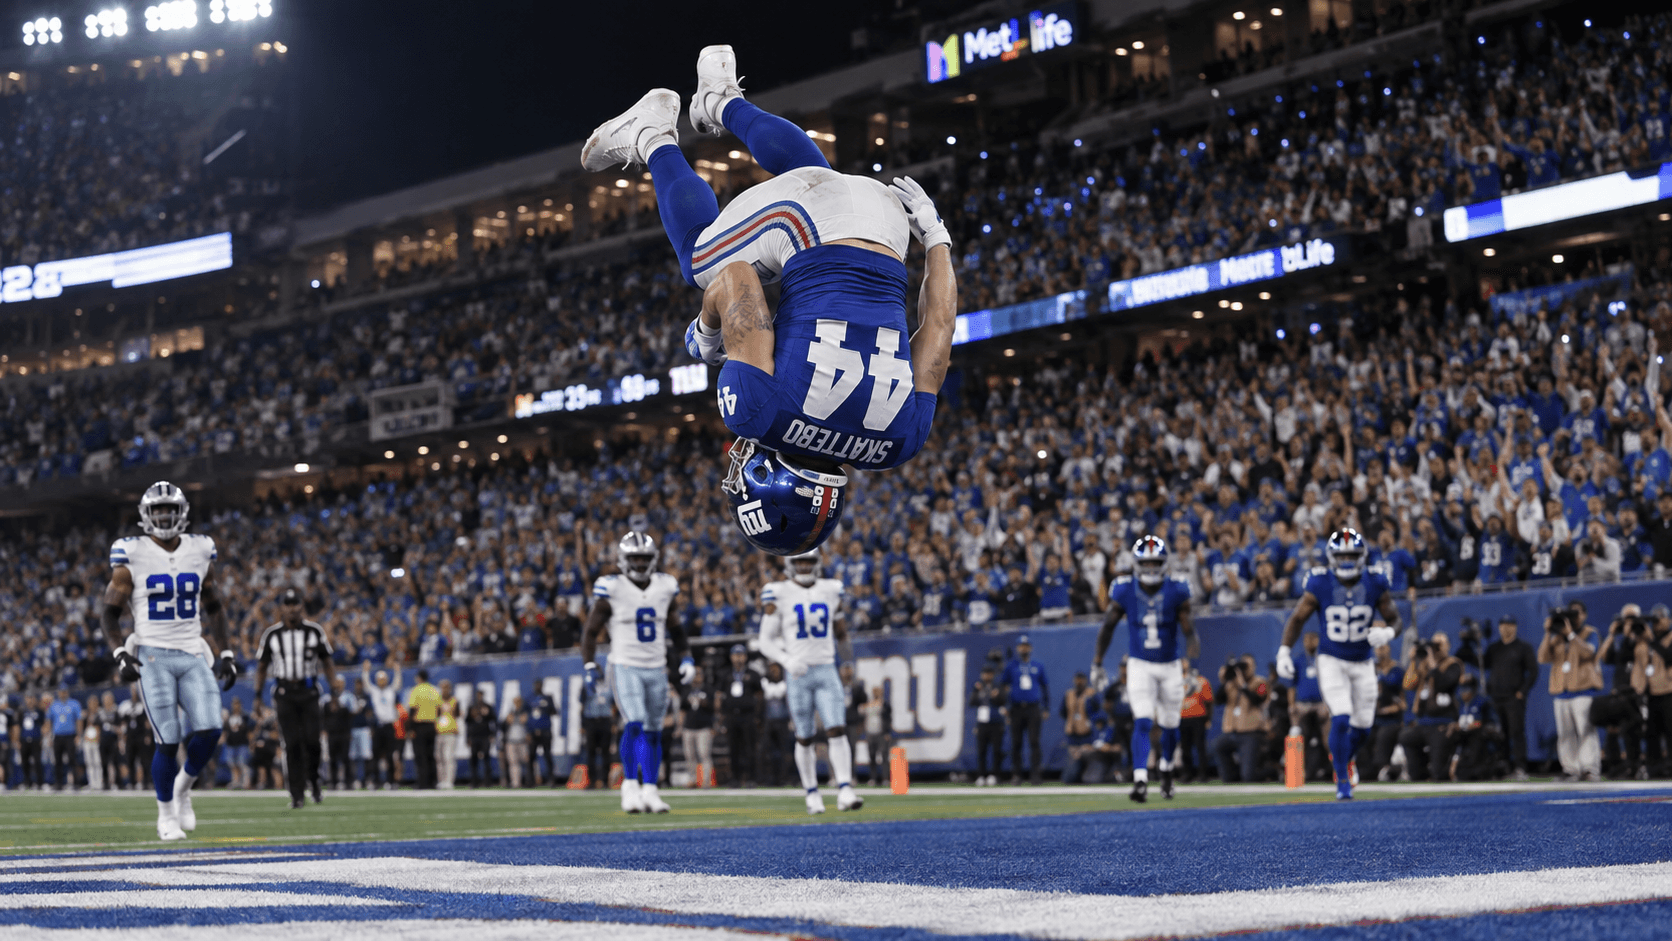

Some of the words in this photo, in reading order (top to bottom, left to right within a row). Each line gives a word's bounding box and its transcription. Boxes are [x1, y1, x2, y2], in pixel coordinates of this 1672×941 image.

[803, 318, 913, 431] 44
[782, 418, 893, 464] SKATTEBO
[146, 573, 200, 620] 28
[636, 607, 656, 643] 6
[794, 603, 830, 639] 13
[1142, 614, 1162, 649] 1
[1325, 604, 1373, 643] 82
